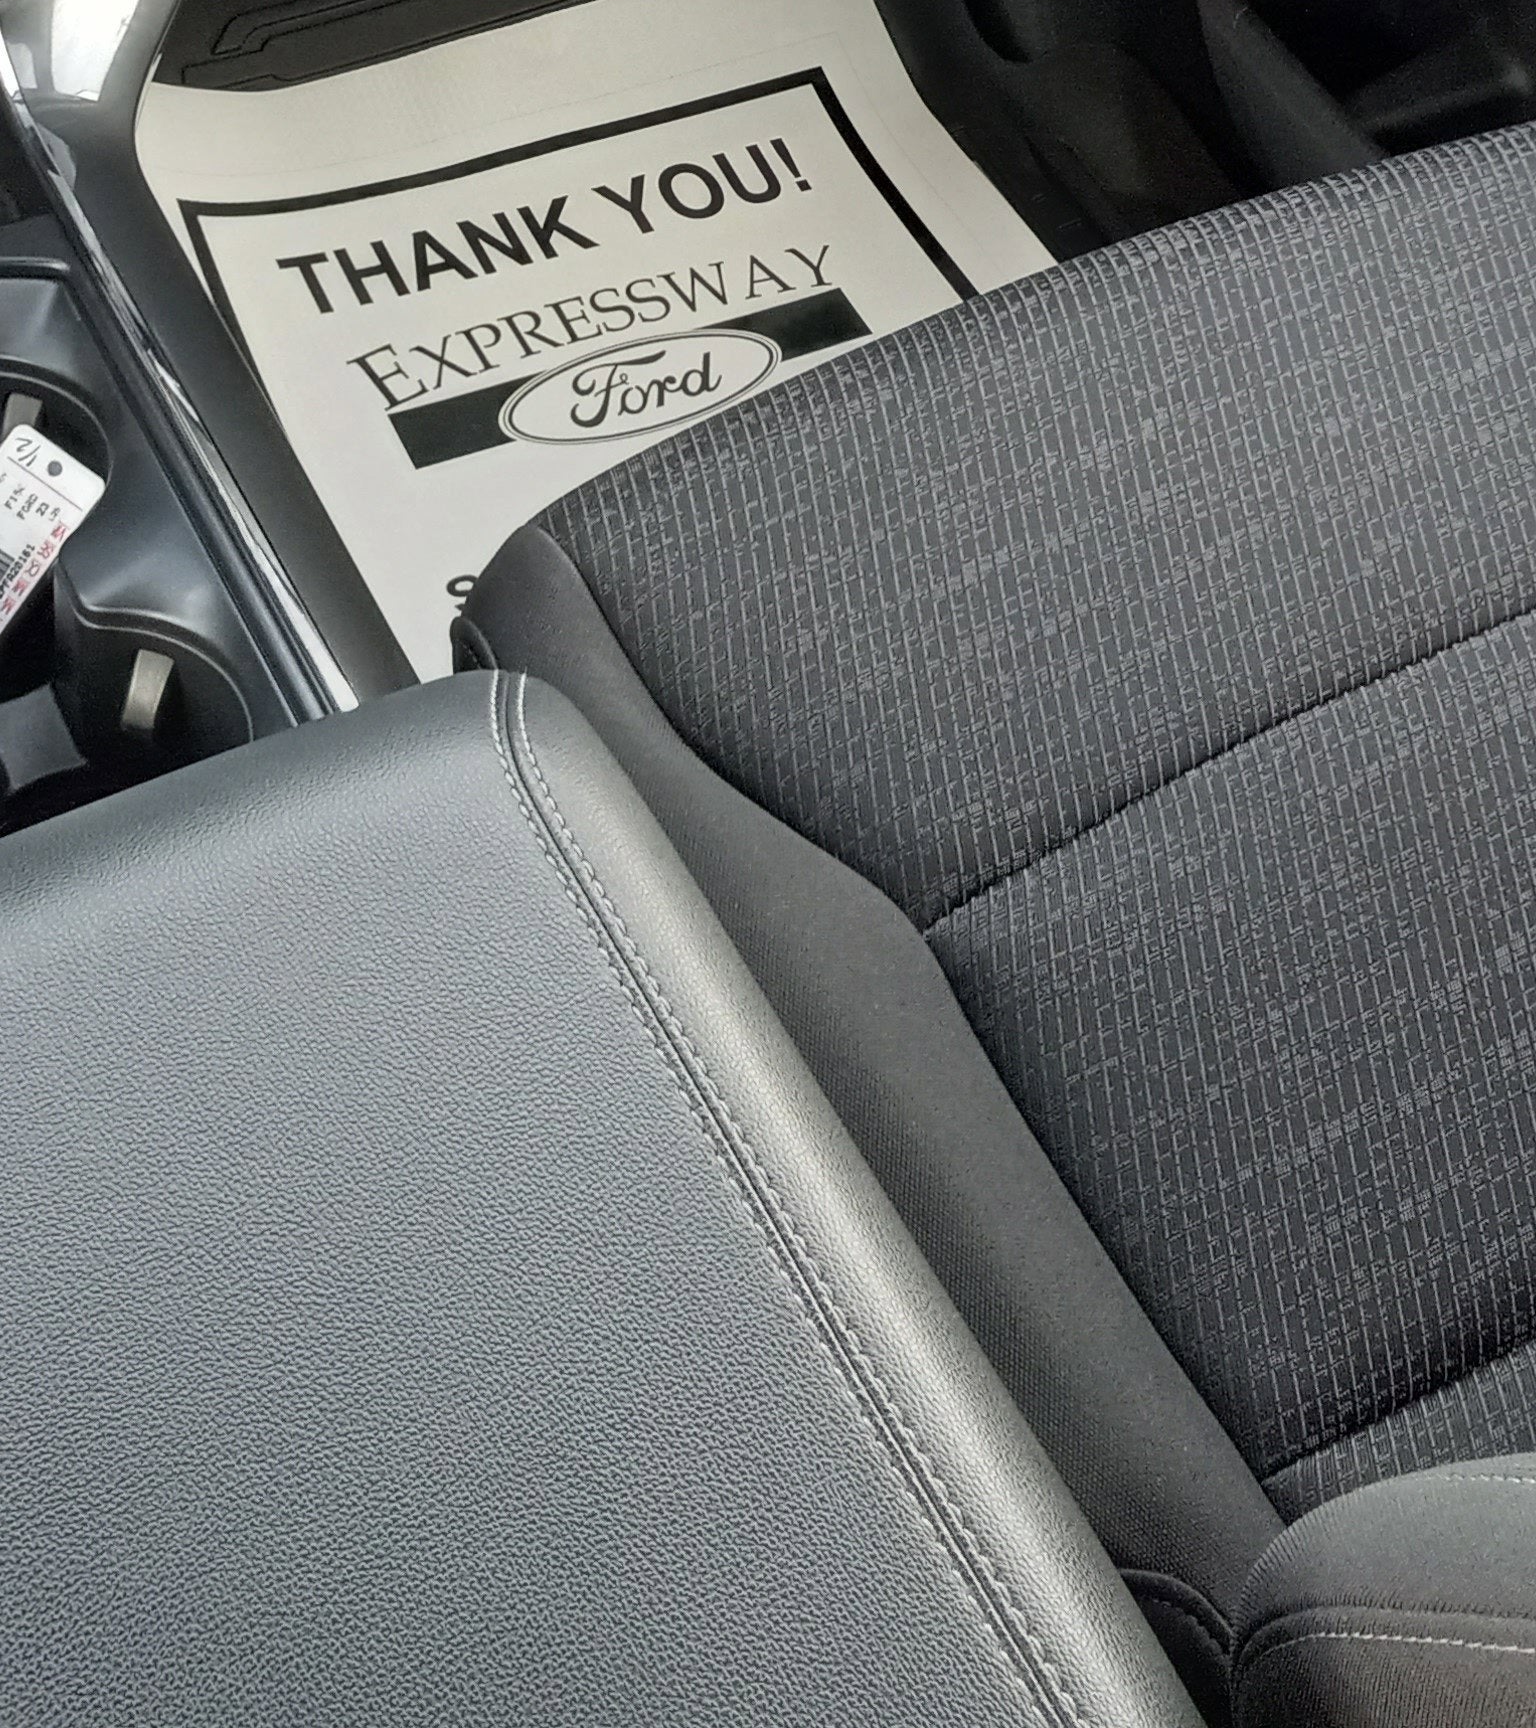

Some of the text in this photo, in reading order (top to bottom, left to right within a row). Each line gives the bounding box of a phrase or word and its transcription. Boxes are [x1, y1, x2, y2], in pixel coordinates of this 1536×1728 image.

[276, 137, 813, 315] THANK YOU!
[569, 349, 723, 430] Ford
